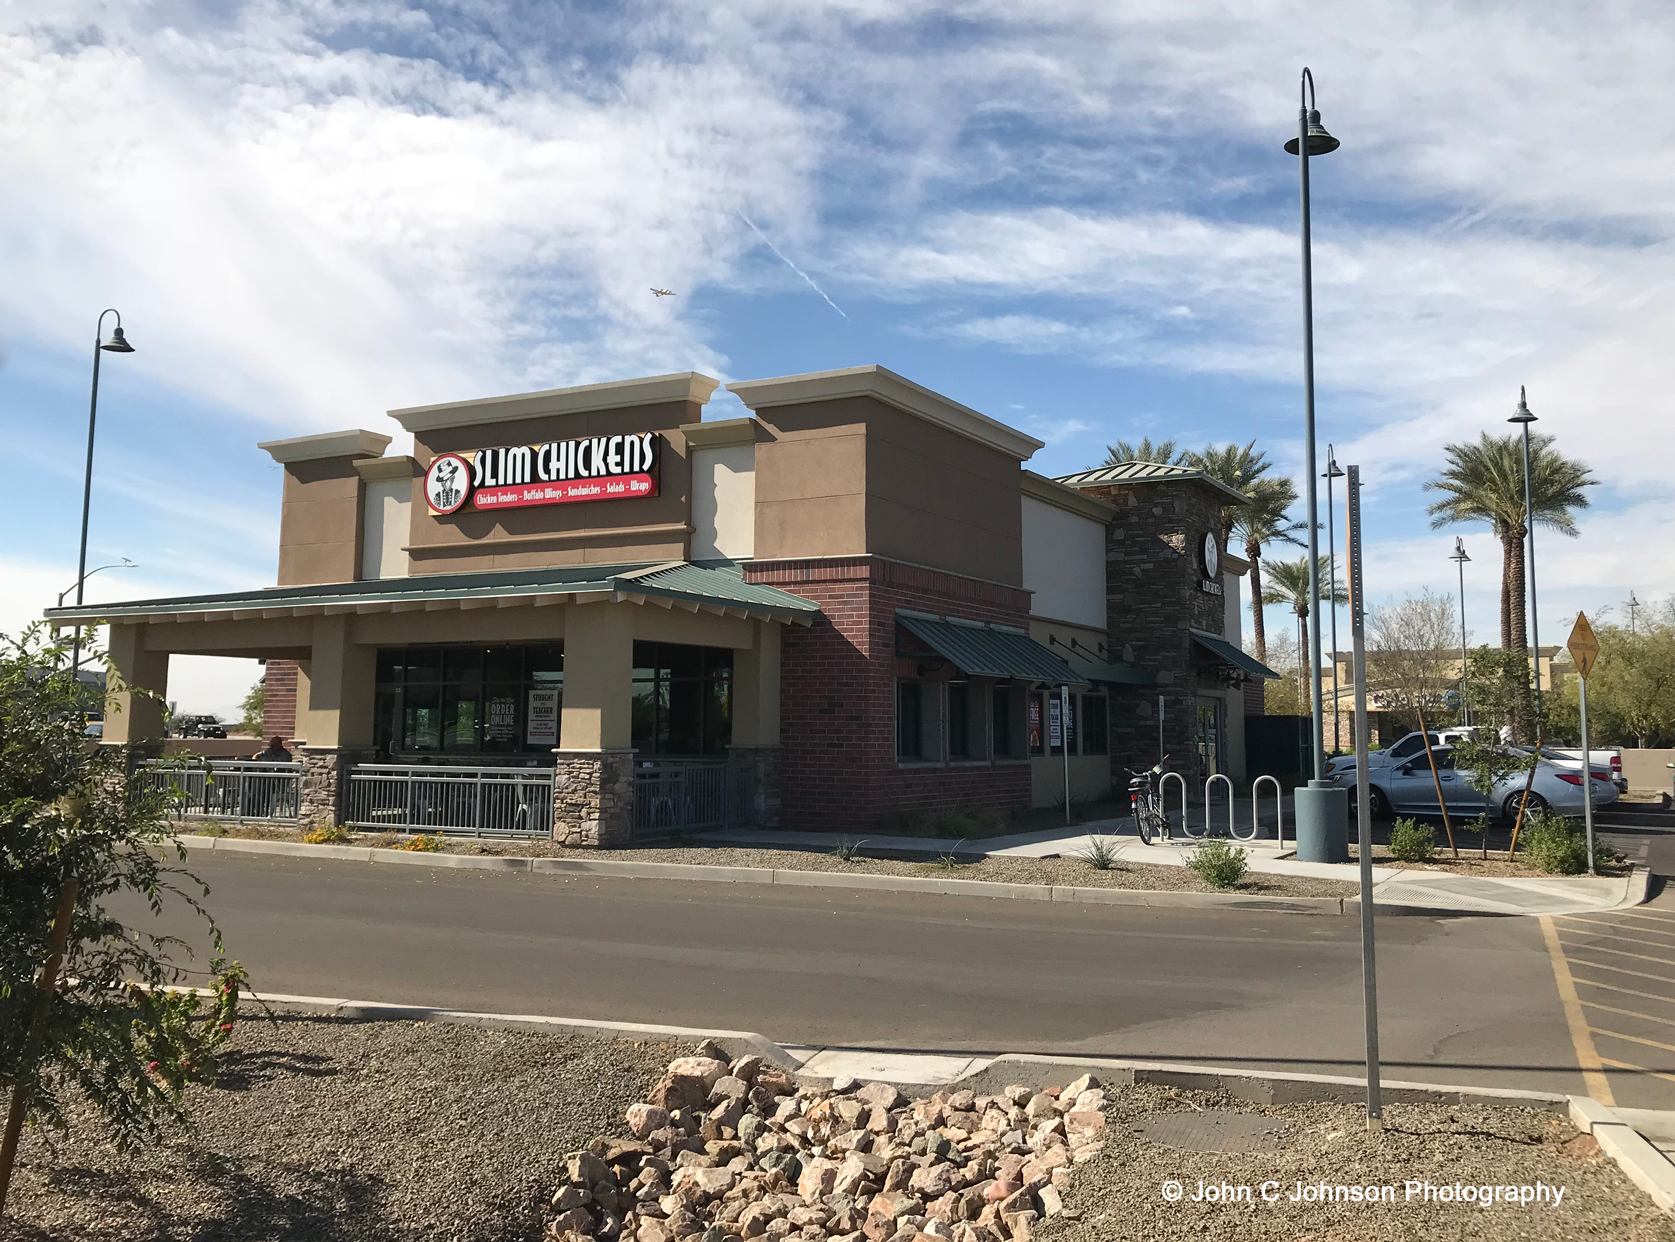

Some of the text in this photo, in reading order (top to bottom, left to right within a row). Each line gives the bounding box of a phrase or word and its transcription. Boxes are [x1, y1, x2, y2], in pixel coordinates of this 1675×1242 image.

[473, 432, 653, 488] SLIM CHICKENS
[477, 493, 498, 505] Chicken
[498, 491, 518, 503] Tenders
[523, 489, 544, 501] Buffalo
[544, 487, 562, 500] Wings
[568, 484, 601, 497] Sandwiches
[606, 481, 625, 493] Salads
[630, 480, 649, 492] Wraps
[532, 693, 554, 702] STUDENT
[491, 703, 515, 715] ORDER
[532, 706, 553, 715] TEACHER
[490, 714, 515, 725] ONLINE
